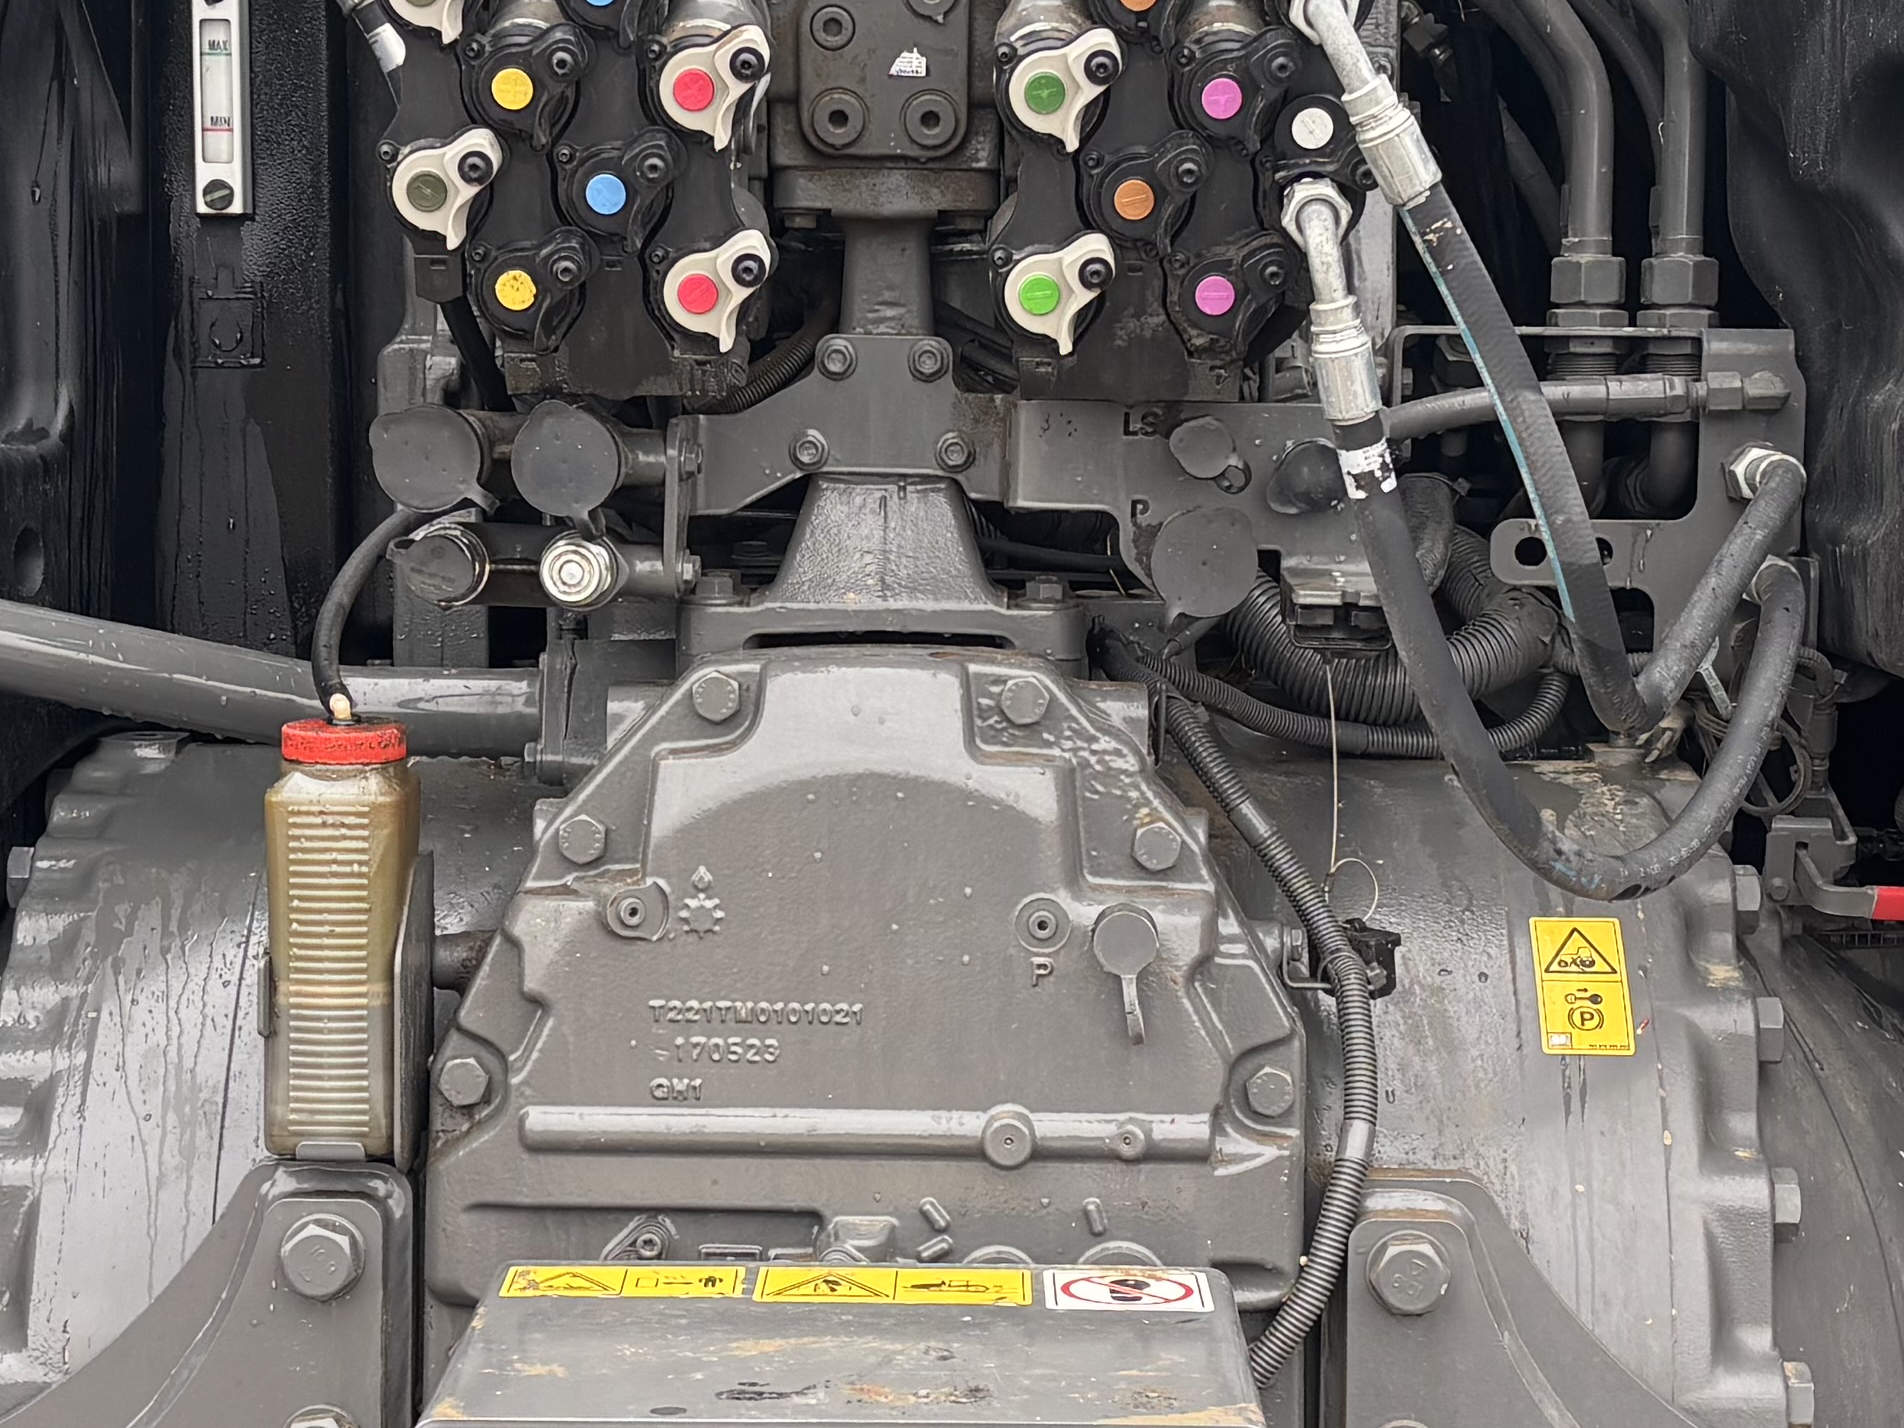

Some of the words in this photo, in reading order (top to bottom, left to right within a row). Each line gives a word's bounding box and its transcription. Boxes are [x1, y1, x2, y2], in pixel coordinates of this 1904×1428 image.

[208, 39, 229, 52] MAX
[210, 115, 231, 128] MIN
[1123, 411, 1160, 438] LS
[1030, 957, 1055, 988] P
